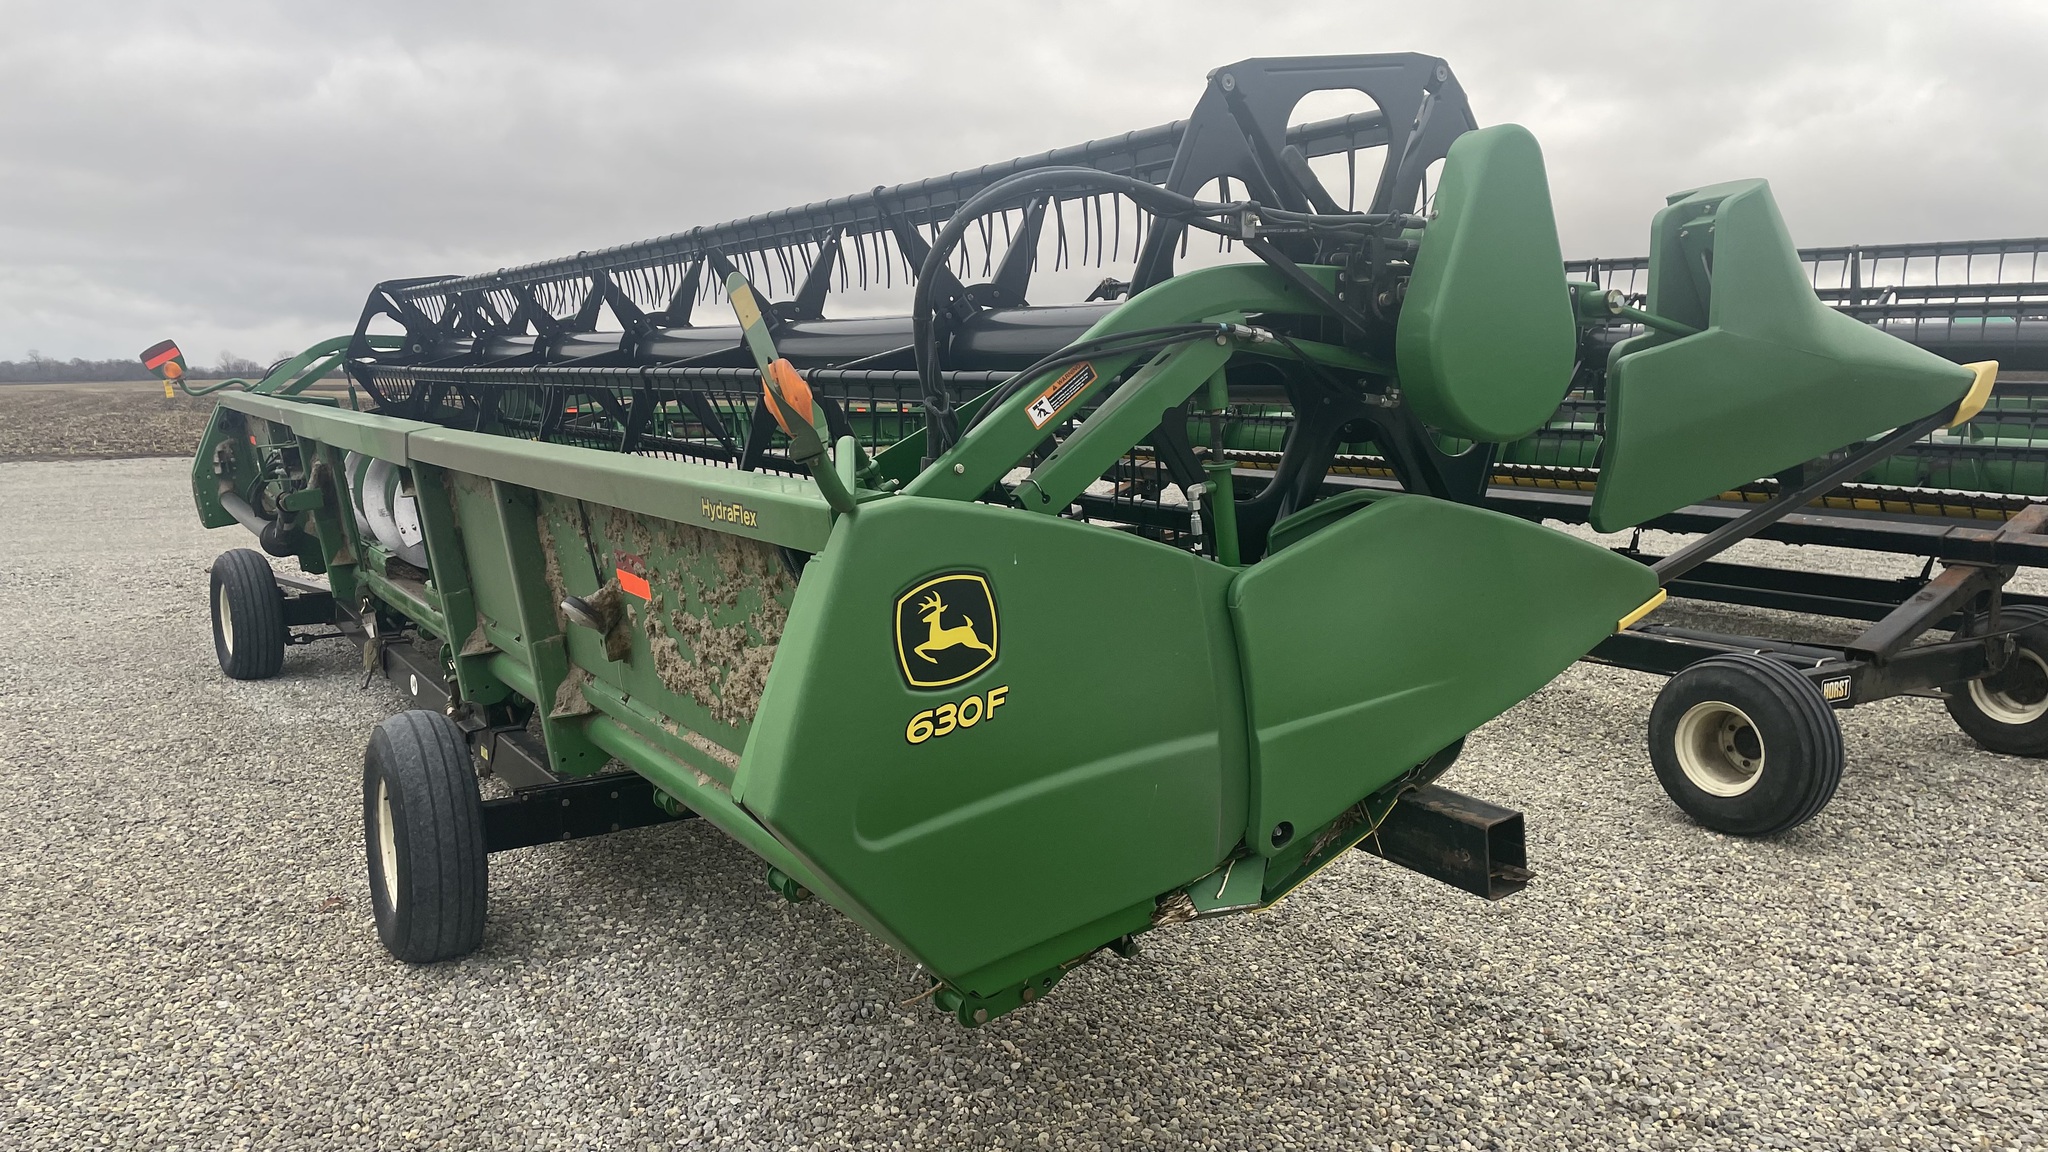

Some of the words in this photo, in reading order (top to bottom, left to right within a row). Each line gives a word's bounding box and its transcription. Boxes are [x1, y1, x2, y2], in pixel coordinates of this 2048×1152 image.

[1057, 364, 1081, 385] WARNING
[701, 497, 758, 527] HydraFlex
[1824, 680, 1849, 699] HORST
[905, 685, 1009, 744] 630F
